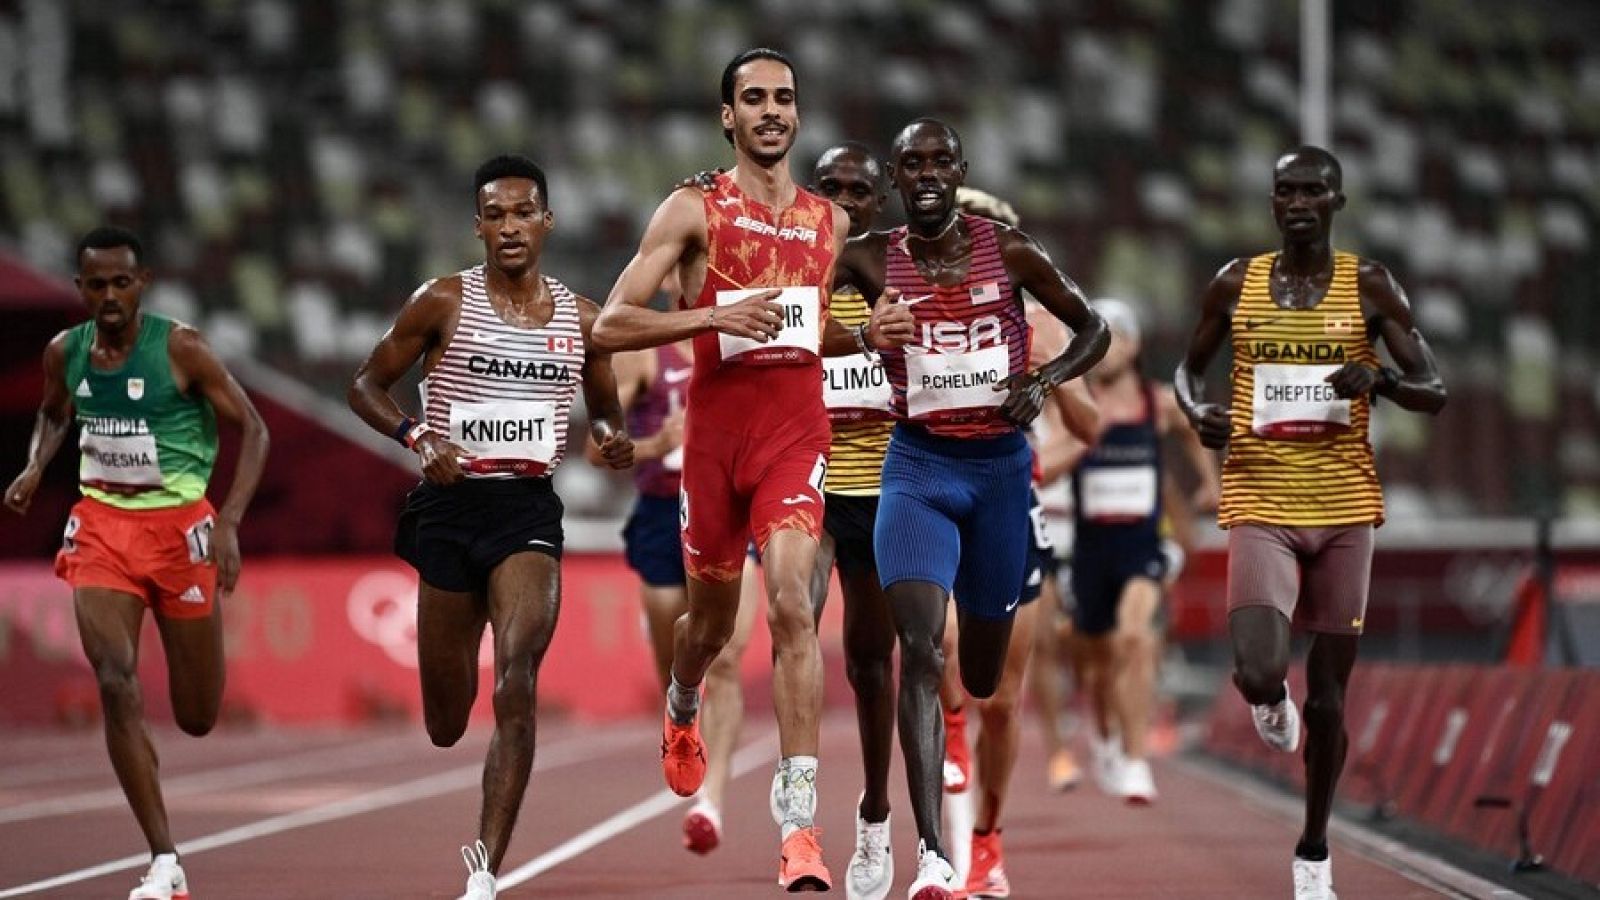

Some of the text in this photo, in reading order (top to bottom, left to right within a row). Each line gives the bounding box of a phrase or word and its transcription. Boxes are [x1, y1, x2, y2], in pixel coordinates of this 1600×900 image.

[1247, 342, 1345, 360] UGANDA
[468, 355, 570, 382] CANADA
[921, 369, 998, 390] P.CHELIMO
[1264, 383, 1335, 402] CHEPTEG
[461, 417, 545, 442] KNIGHT
